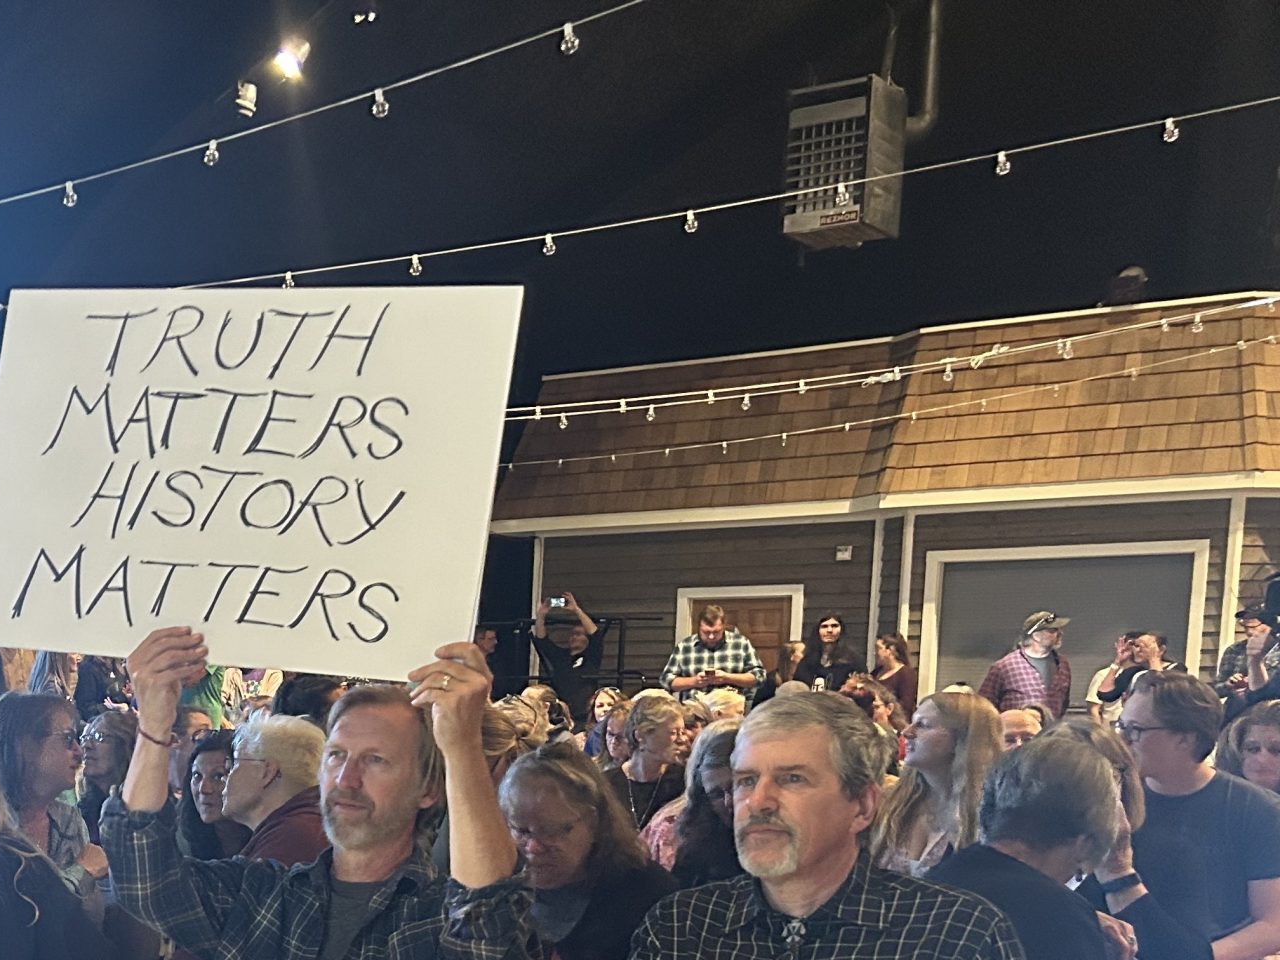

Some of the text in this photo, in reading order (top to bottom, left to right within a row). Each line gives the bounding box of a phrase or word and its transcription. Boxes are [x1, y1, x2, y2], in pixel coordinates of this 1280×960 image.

[85, 302, 391, 380] TRUTH
[42, 383, 410, 460] MATTERS
[71, 461, 406, 547] HISTORY
[11, 544, 400, 644] MATTERS
